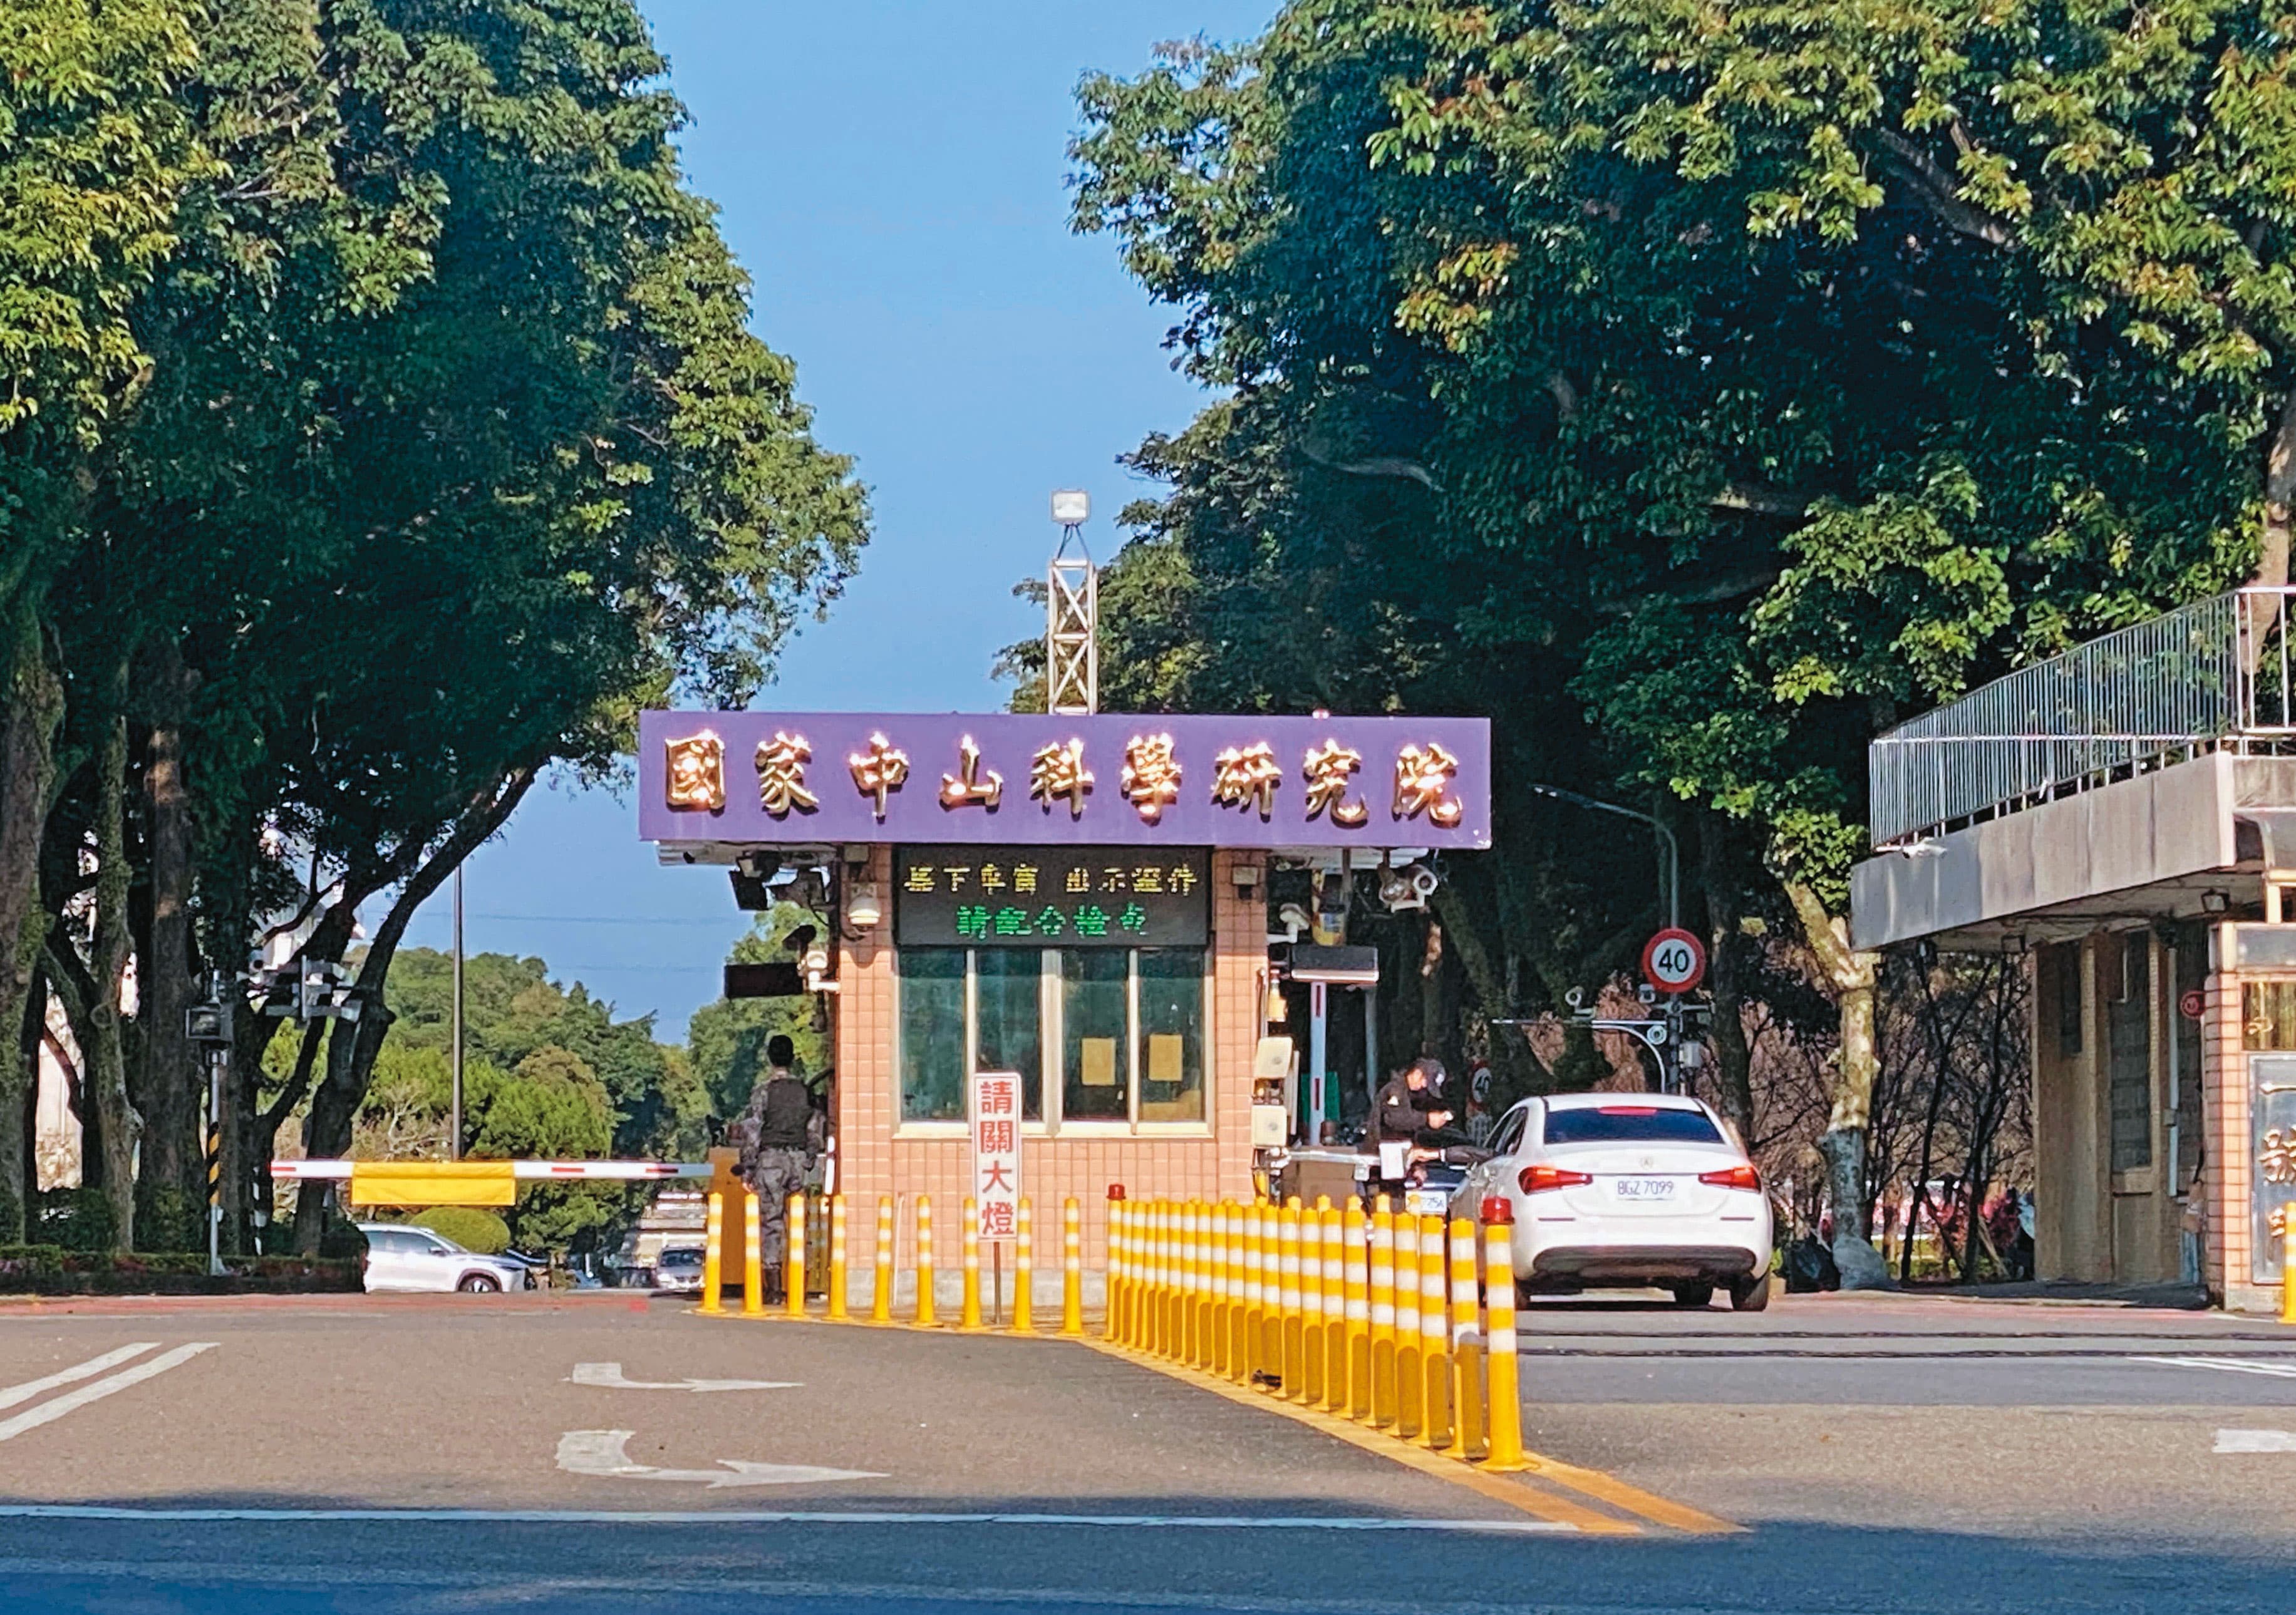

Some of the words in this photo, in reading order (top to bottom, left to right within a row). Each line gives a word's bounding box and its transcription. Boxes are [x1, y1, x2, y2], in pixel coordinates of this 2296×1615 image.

[664, 729, 1462, 827] 國家中山科學研究院
[1658, 948, 1690, 973] 40
[980, 1081, 1014, 1236] 請關大燈
